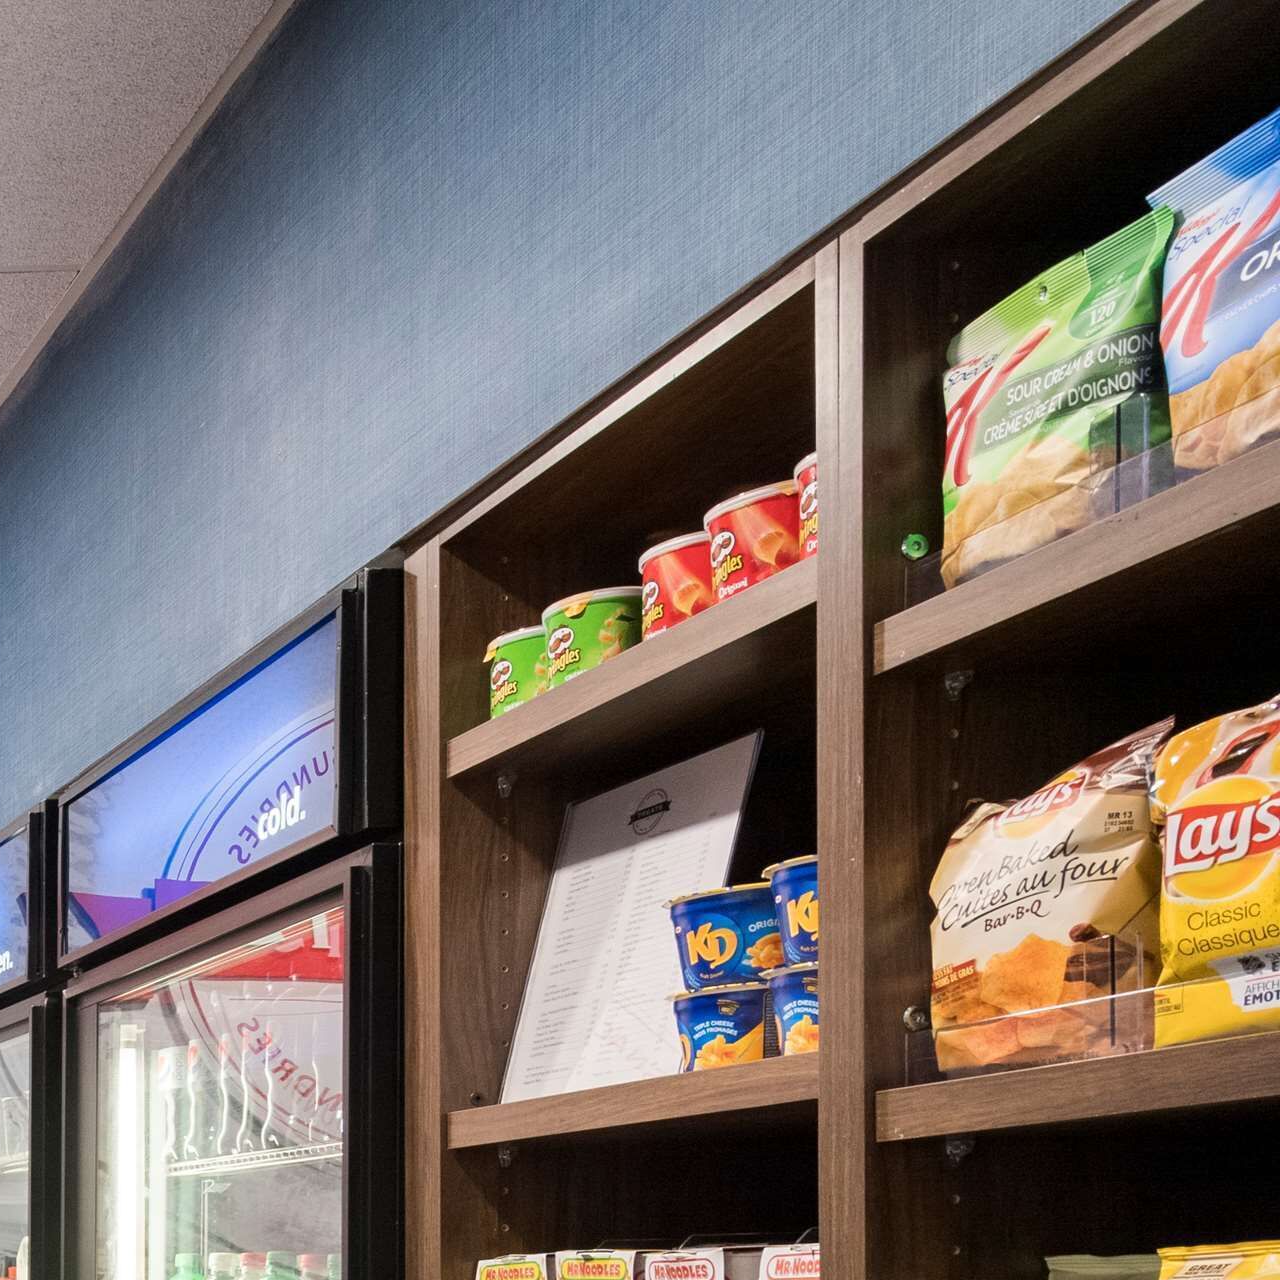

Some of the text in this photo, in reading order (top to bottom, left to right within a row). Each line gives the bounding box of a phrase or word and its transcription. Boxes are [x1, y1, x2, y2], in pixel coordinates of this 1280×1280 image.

[1006, 332, 1155, 406] SOUR CREAM & ONION
[983, 415, 1020, 445] CRÈME
[255, 785, 306, 842] cold.
[998, 828, 1080, 876] Baked
[941, 855, 1129, 932] Cuites au four
[1187, 901, 1262, 932] Classic
[686, 922, 738, 969] KD
[958, 966, 976, 981] GRAS
[707, 1027, 738, 1037] FROMAGES
[711, 1019, 735, 1029] CHEESE
[498, 1266, 536, 1280] NOODLES
[580, 1261, 621, 1276] NOODLES
[667, 1264, 709, 1280] NOODLES
